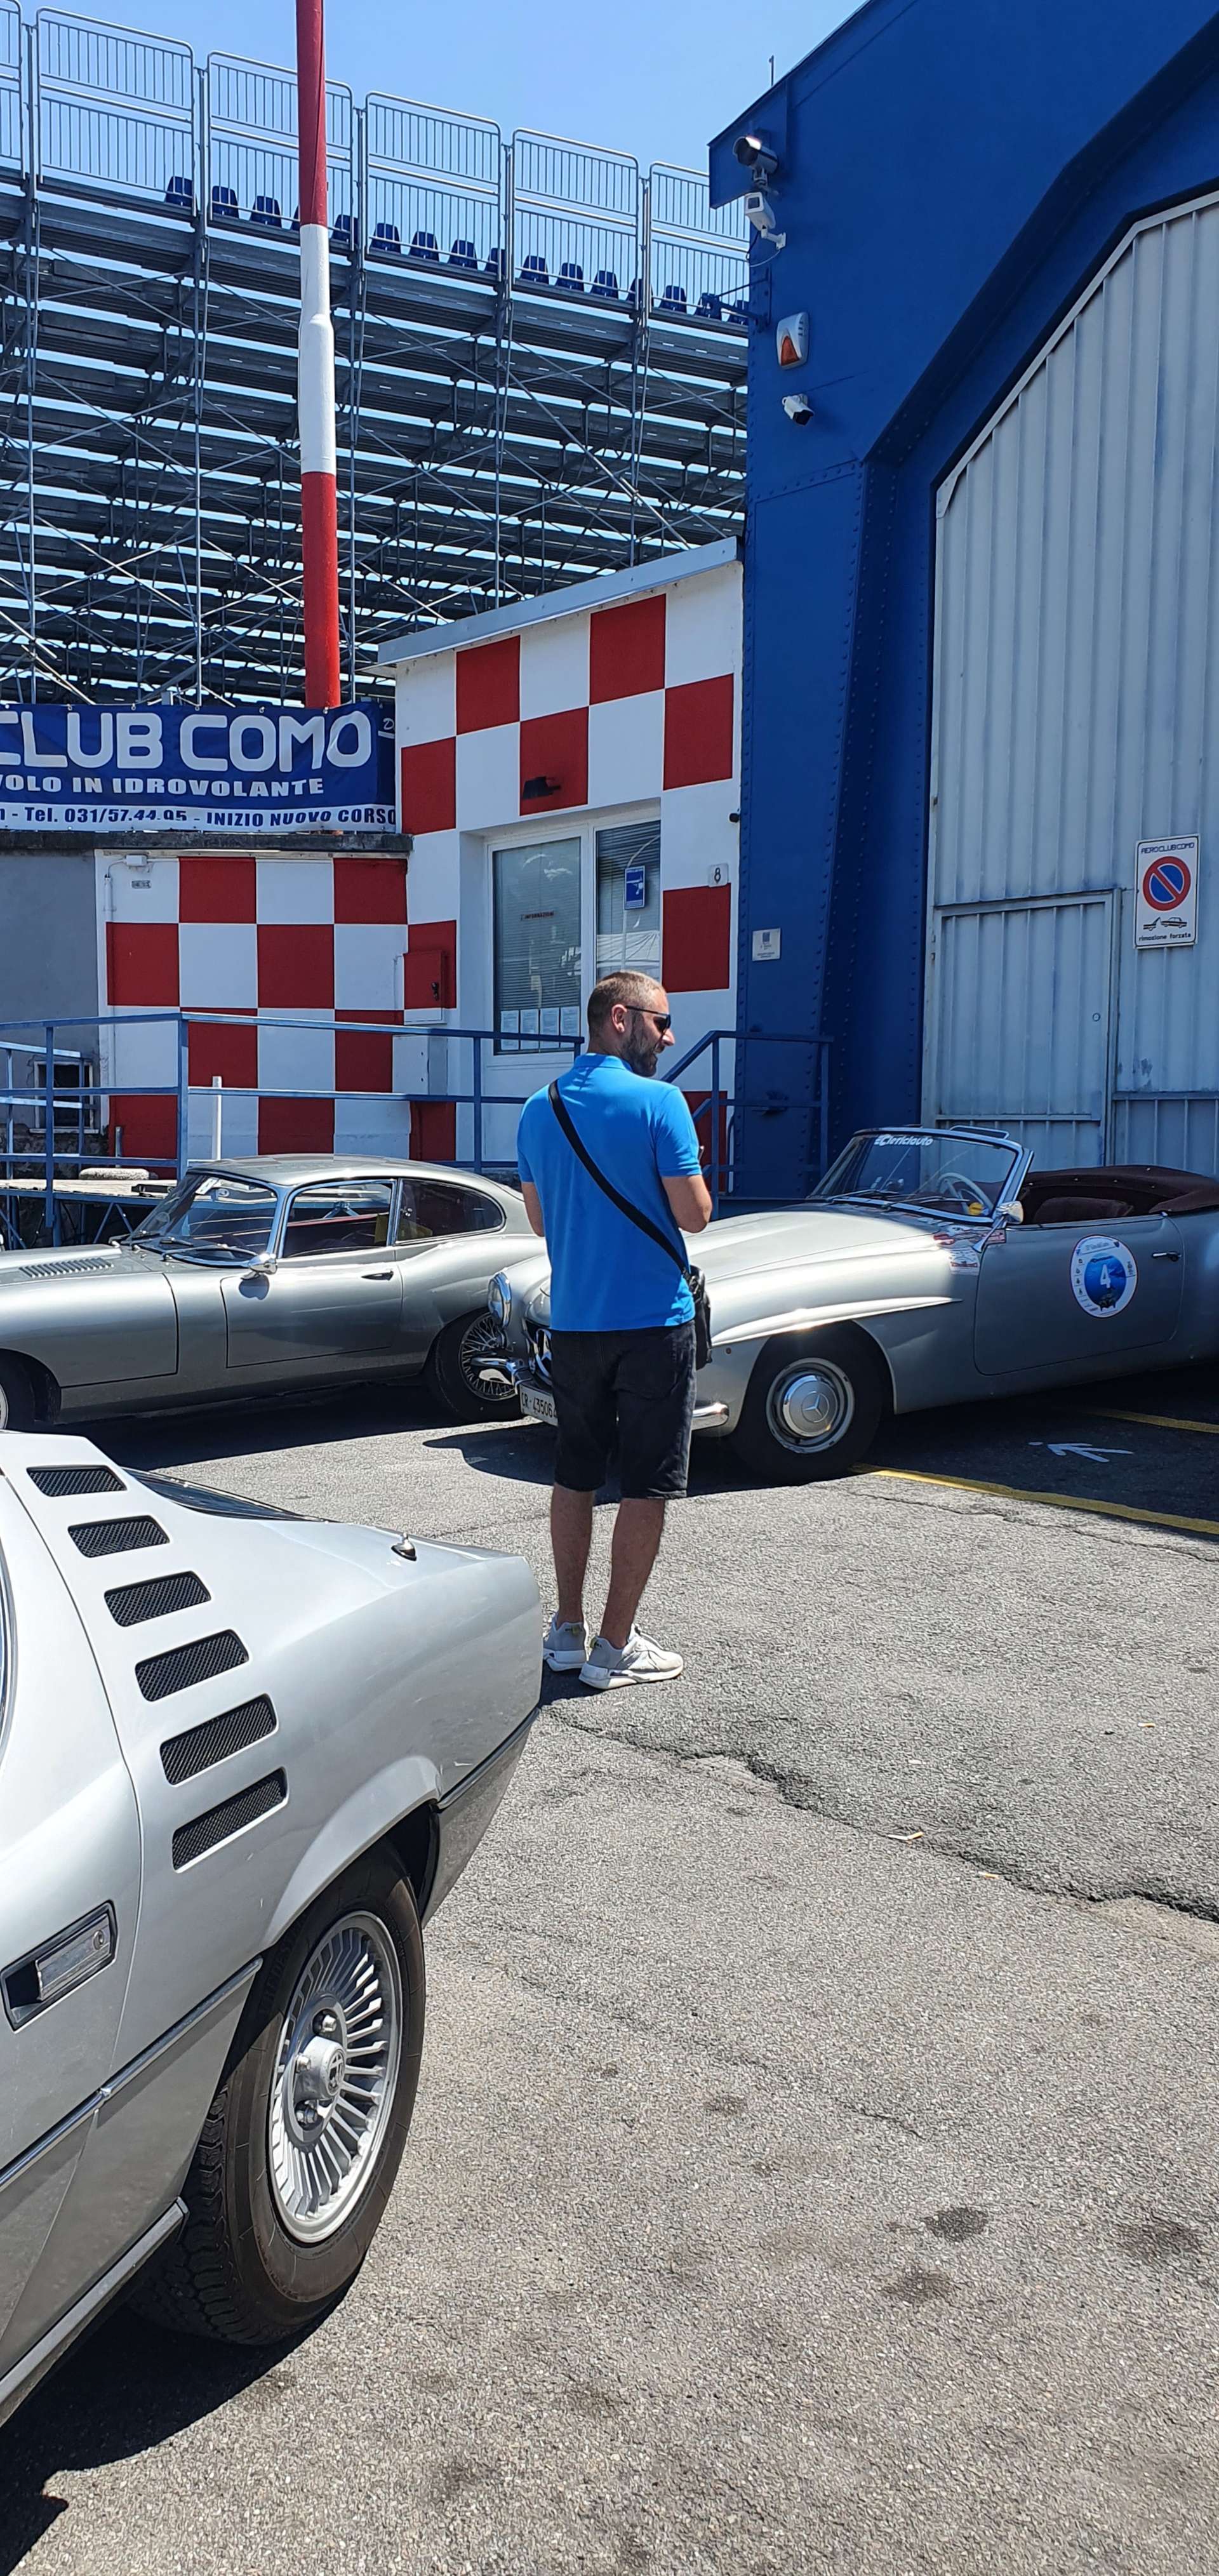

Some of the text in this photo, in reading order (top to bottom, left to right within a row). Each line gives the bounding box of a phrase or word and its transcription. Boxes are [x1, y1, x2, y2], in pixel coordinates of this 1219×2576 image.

[180, 711, 371, 772] COMO
[0, 774, 324, 797] OLO IN IDROVOLANTE
[25, 807, 58, 822] Tel.
[207, 812, 263, 826] INIZIO
[270, 811, 331, 825] NUOVO
[1100, 1264, 1111, 1288] 4
